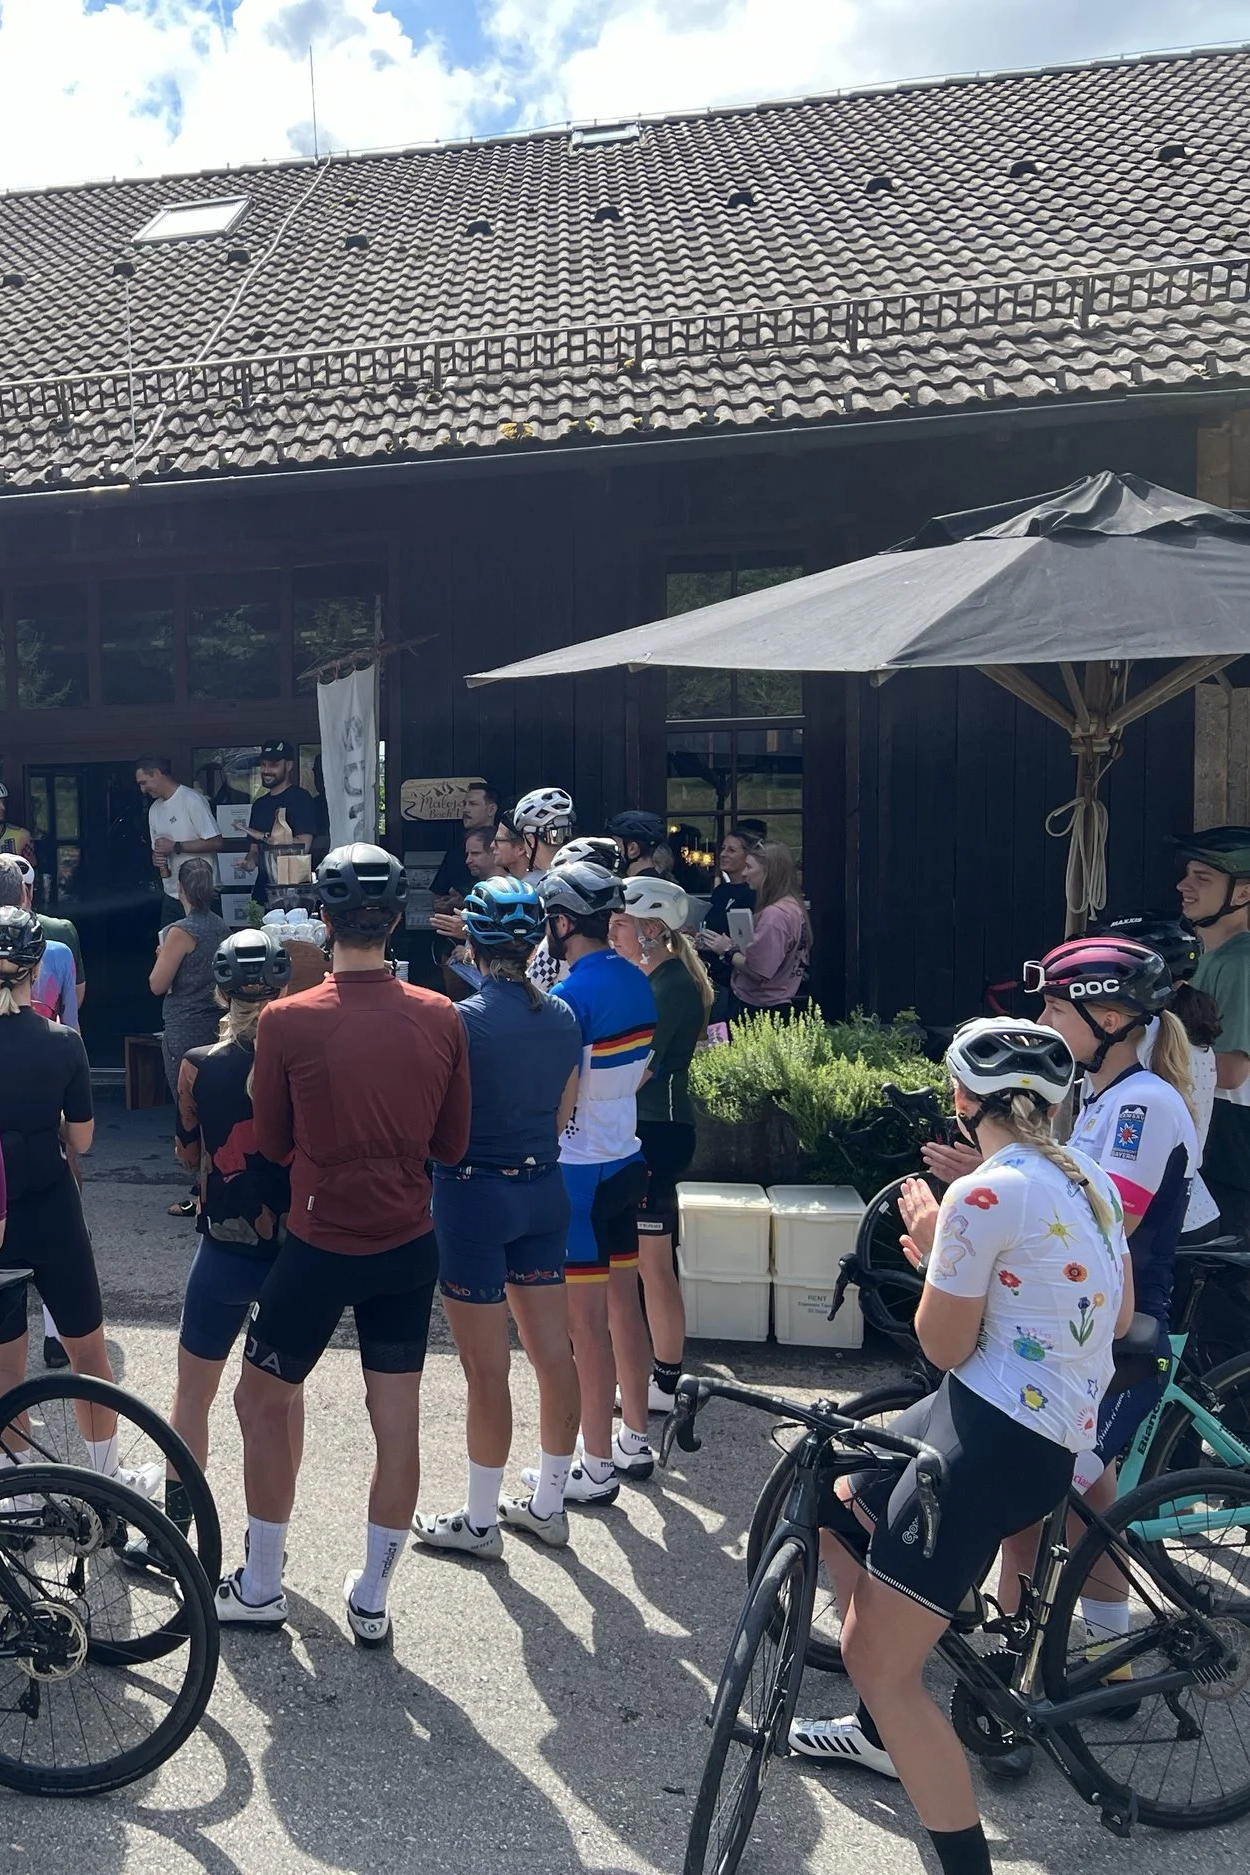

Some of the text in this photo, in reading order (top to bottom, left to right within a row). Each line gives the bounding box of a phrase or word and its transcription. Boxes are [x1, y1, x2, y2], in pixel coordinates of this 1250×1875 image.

[245, 1336, 282, 1376] JA
[1138, 1402, 1162, 1456] Bianc
[381, 1547, 397, 1578] maloja
